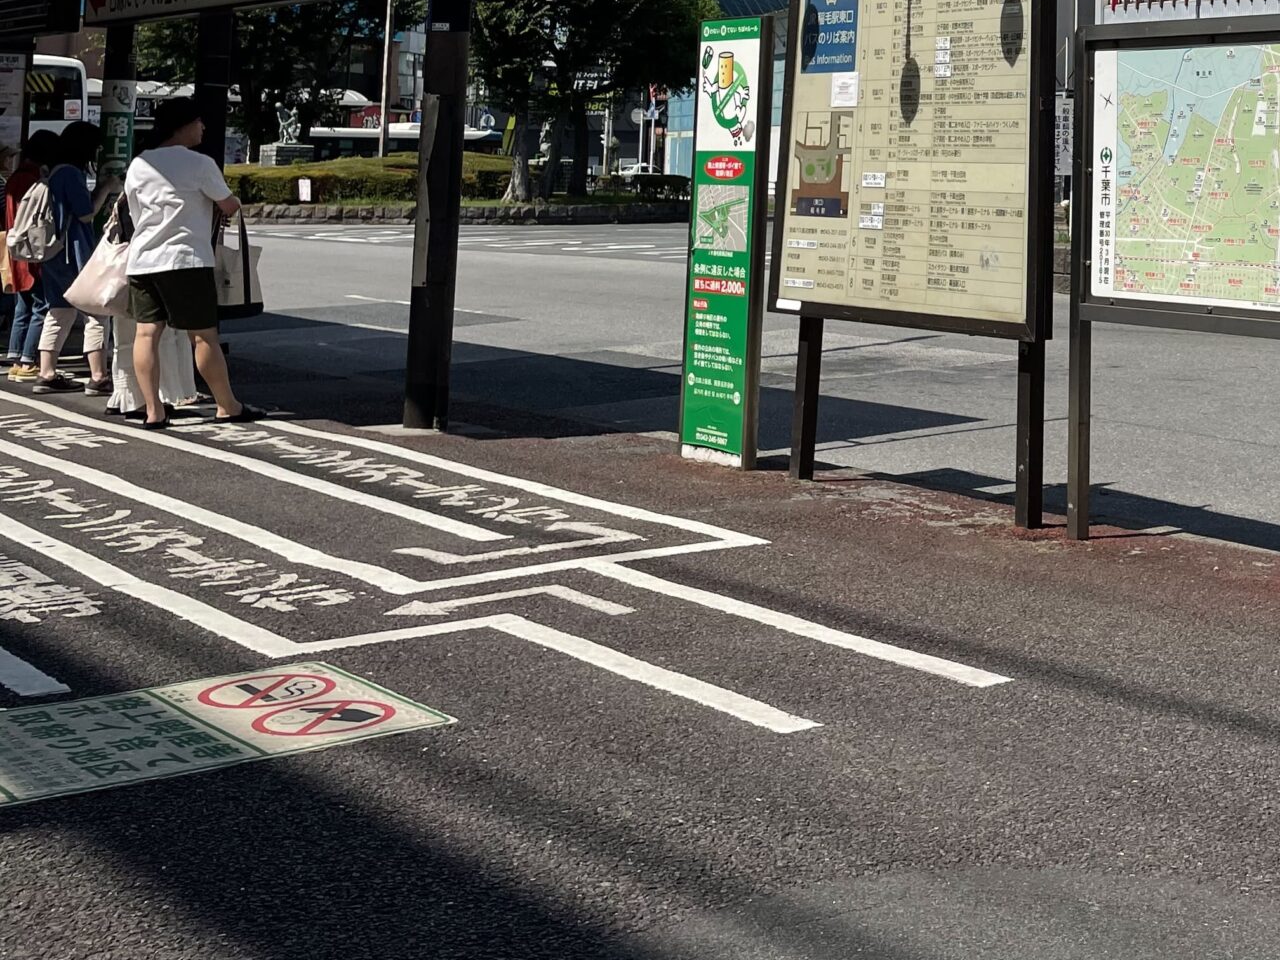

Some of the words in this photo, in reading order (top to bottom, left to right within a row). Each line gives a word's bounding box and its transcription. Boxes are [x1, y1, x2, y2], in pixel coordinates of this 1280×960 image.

[817, 53, 853, 65] Information
[1101, 165, 1111, 206] 千葉市
[8, 711, 141, 778] 取締り地区
[57, 704, 190, 768] ポイ捨て
[101, 696, 243, 758] 路上喫煙等
